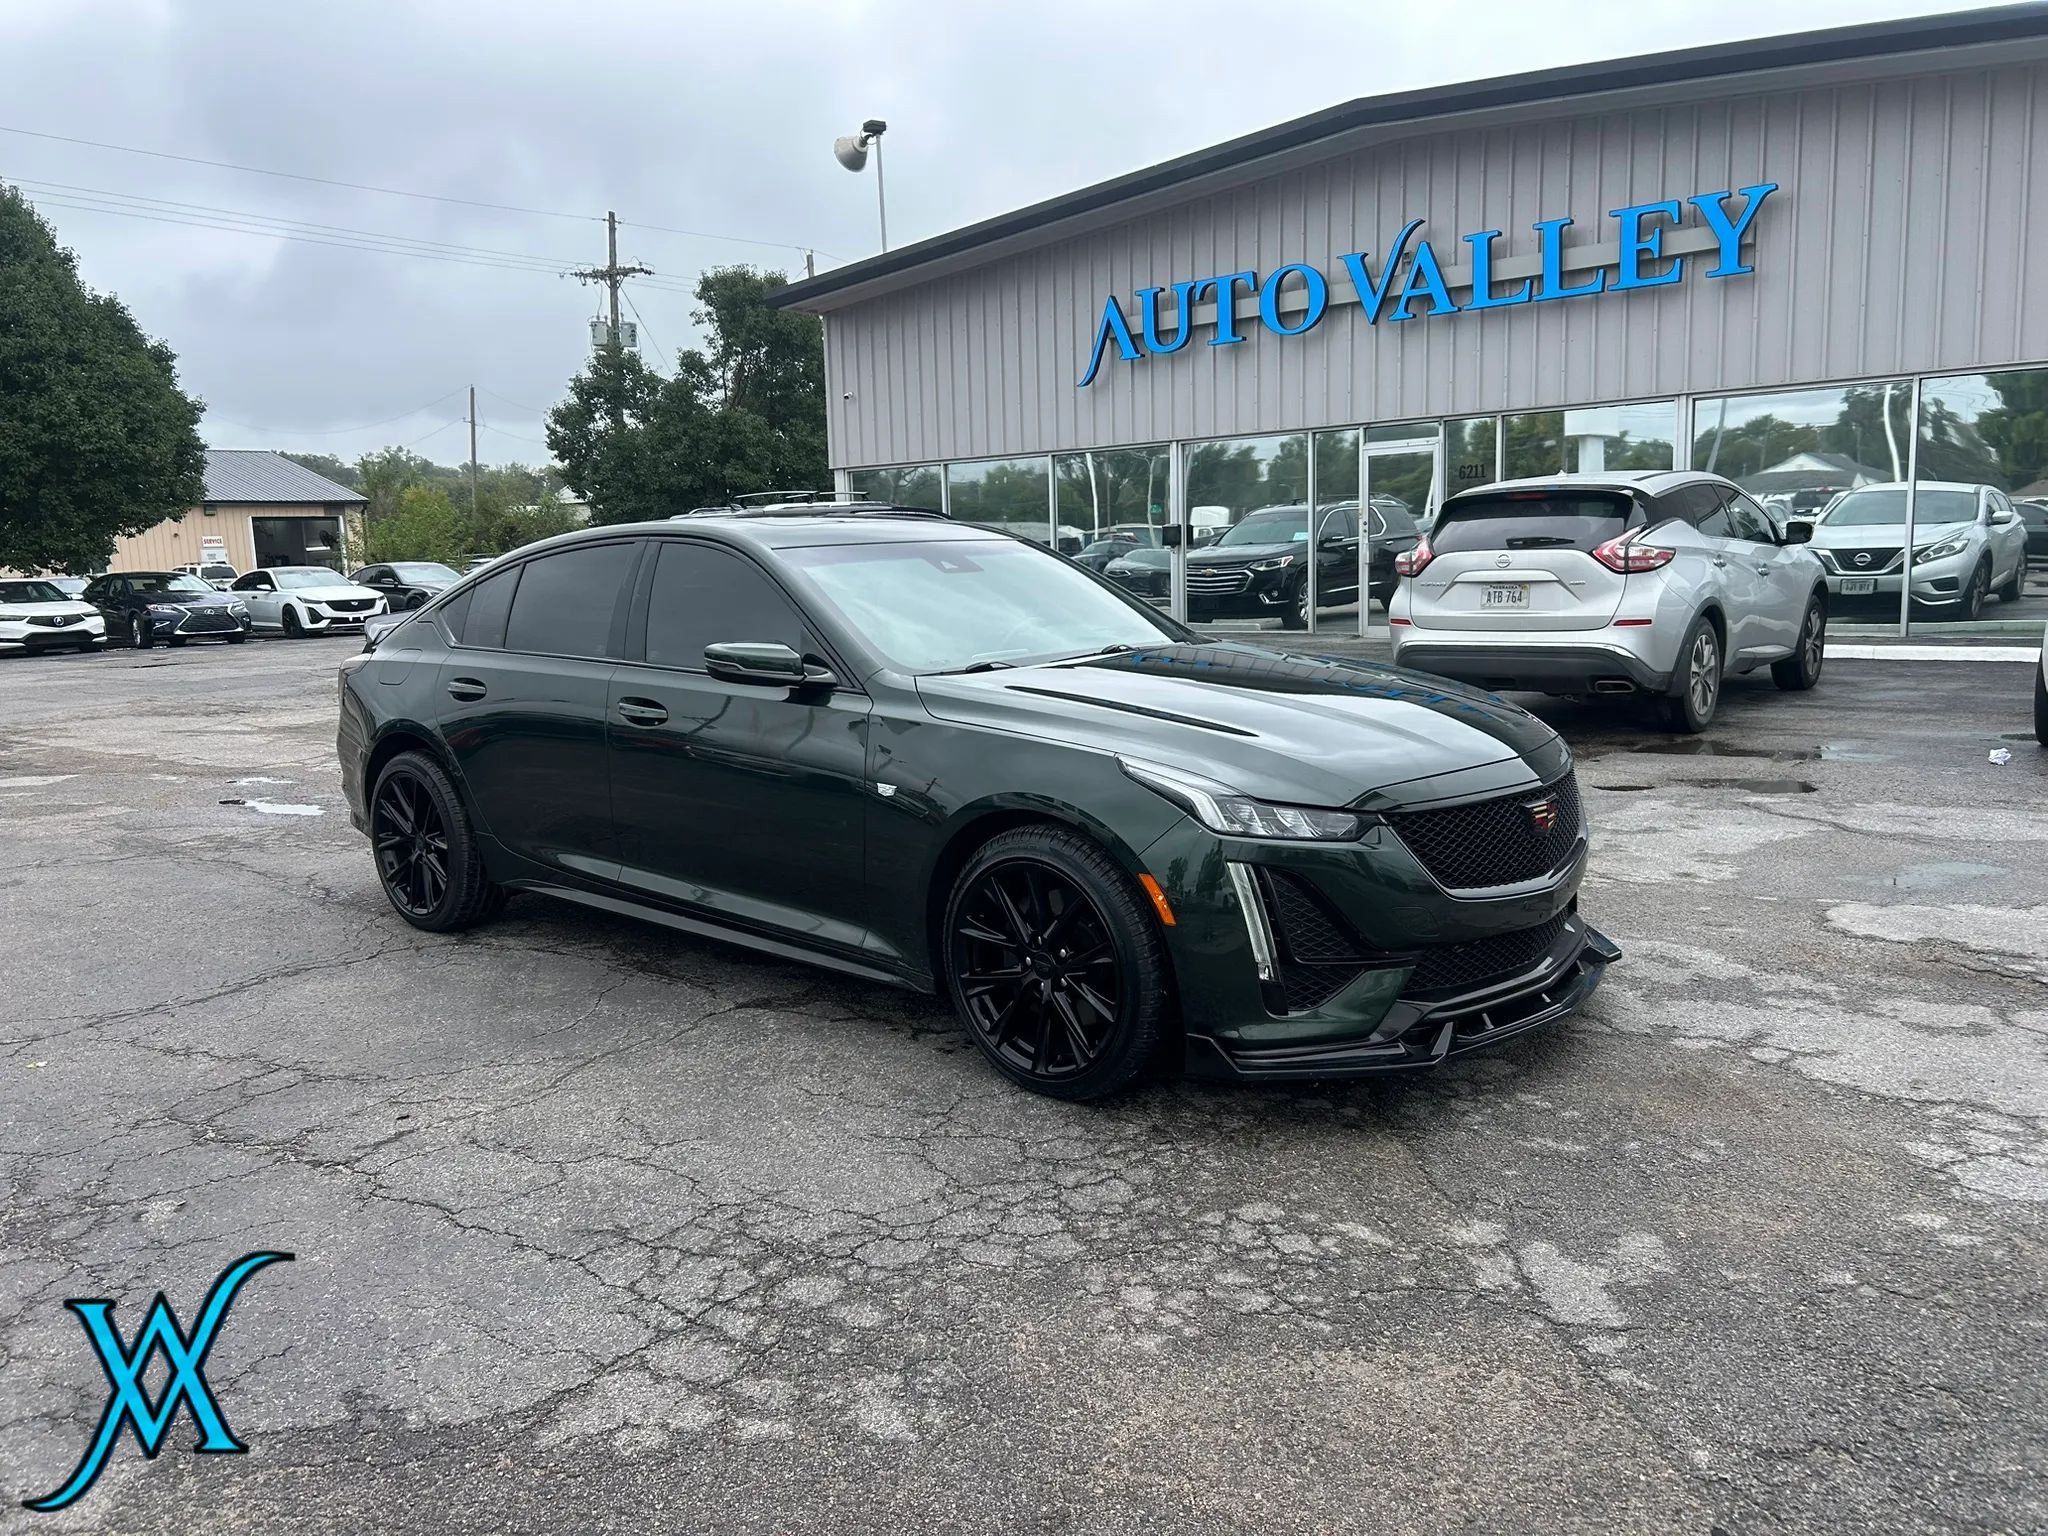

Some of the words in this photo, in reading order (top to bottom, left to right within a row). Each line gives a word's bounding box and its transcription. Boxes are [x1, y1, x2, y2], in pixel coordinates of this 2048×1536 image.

[1077, 262, 1330, 388] AUTO
[1336, 182, 1779, 326] VALLEY
[1458, 463, 1487, 480] 6211
[1506, 590, 1522, 603] 764
